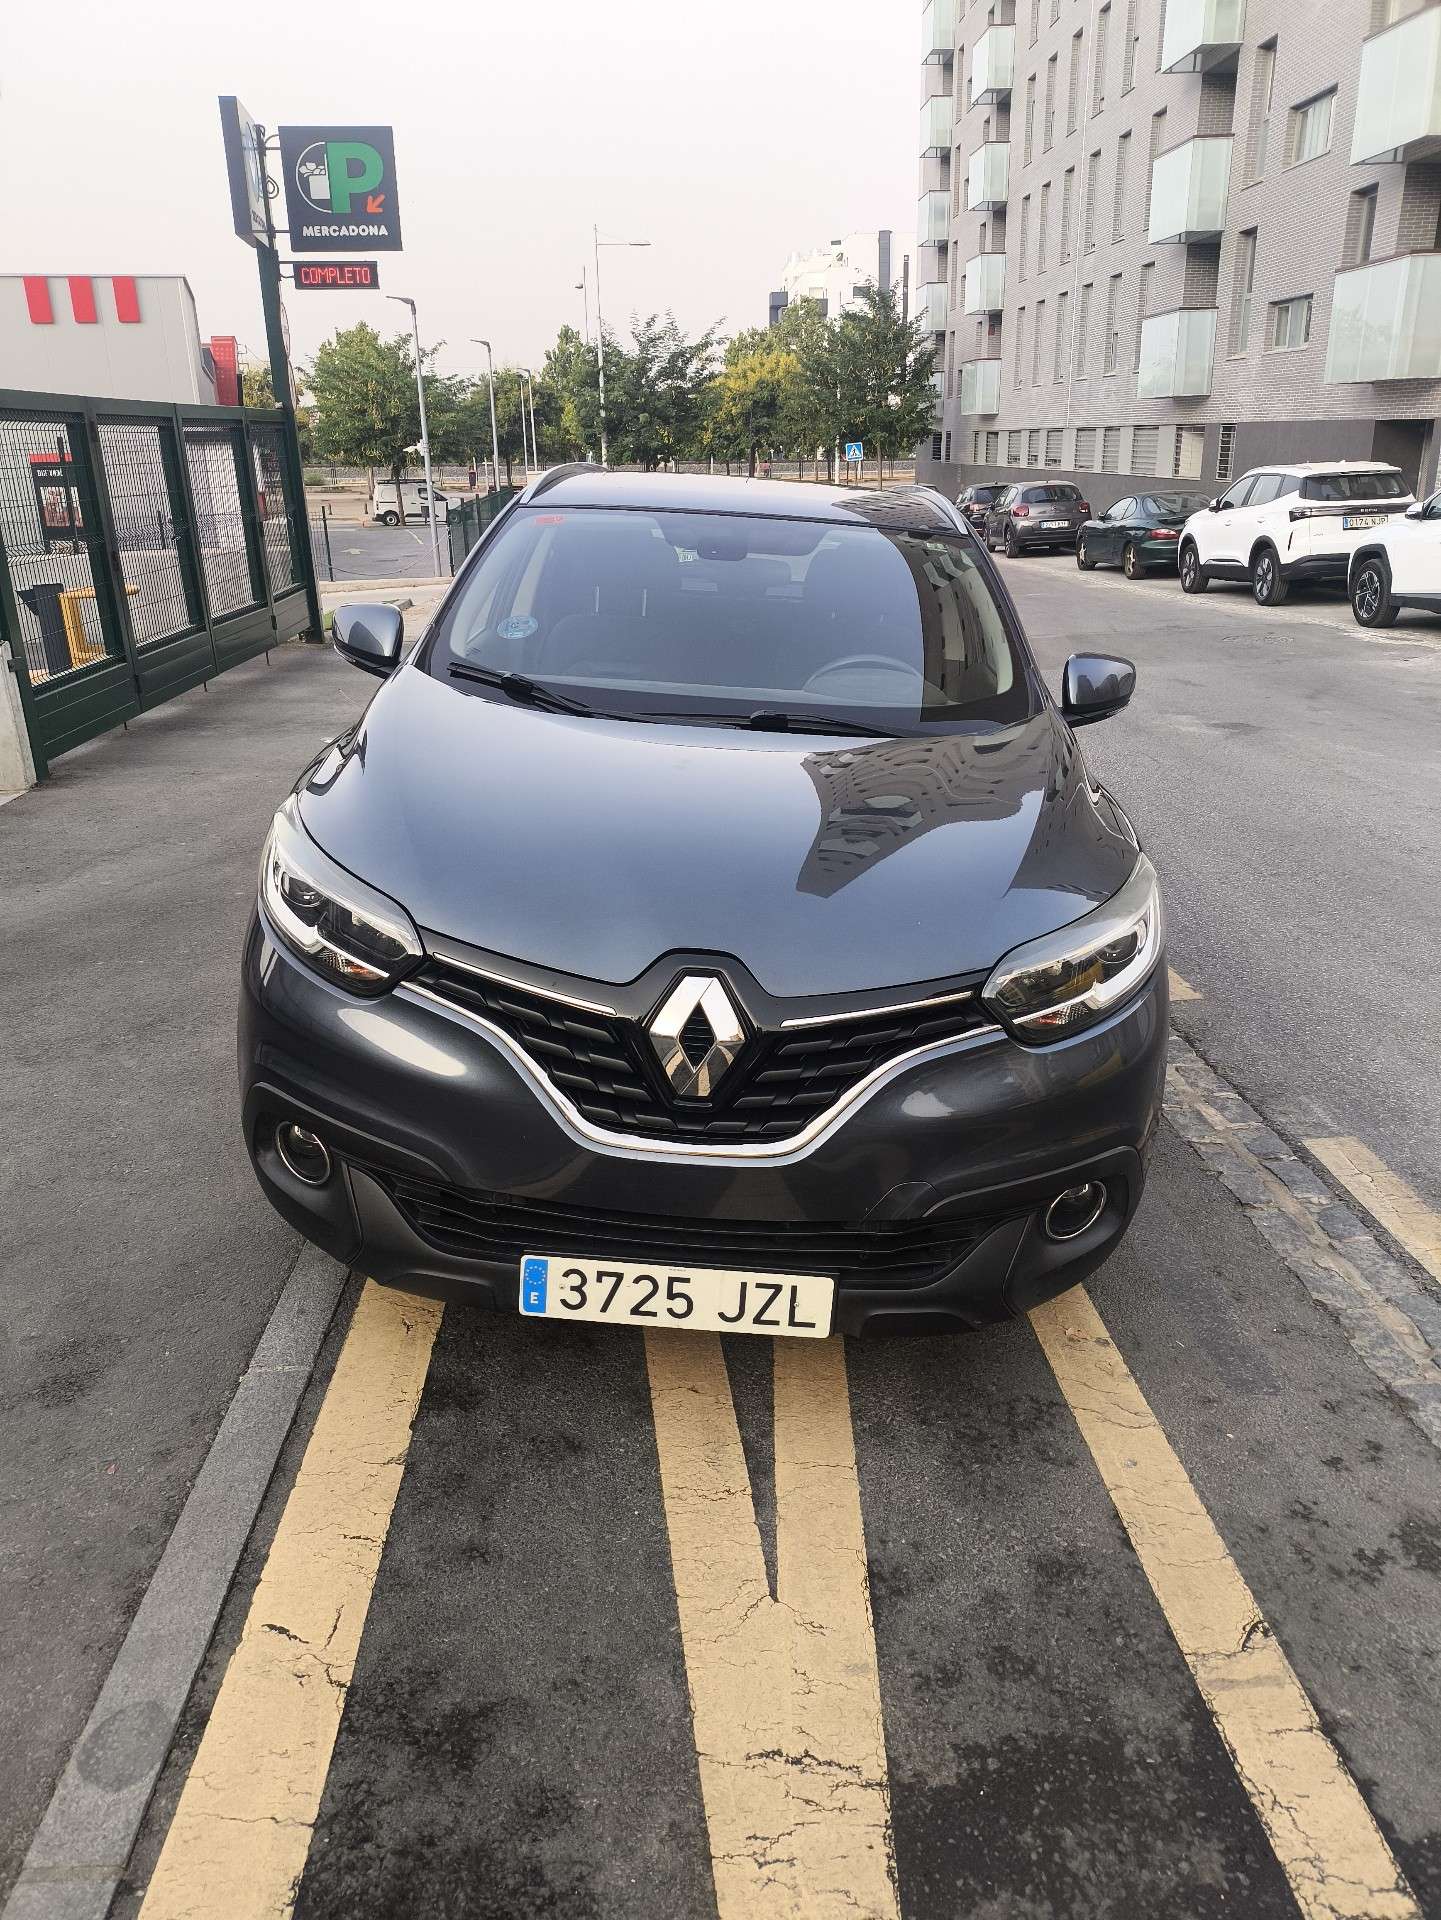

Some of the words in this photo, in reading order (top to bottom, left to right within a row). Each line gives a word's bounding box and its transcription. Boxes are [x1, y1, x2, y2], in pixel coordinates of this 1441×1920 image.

[302, 224, 389, 237] MERCADONA
[302, 267, 371, 285] COMPLETO
[530, 1292, 538, 1304] E
[559, 1268, 694, 1320] 3725
[717, 1281, 817, 1329] JZL
